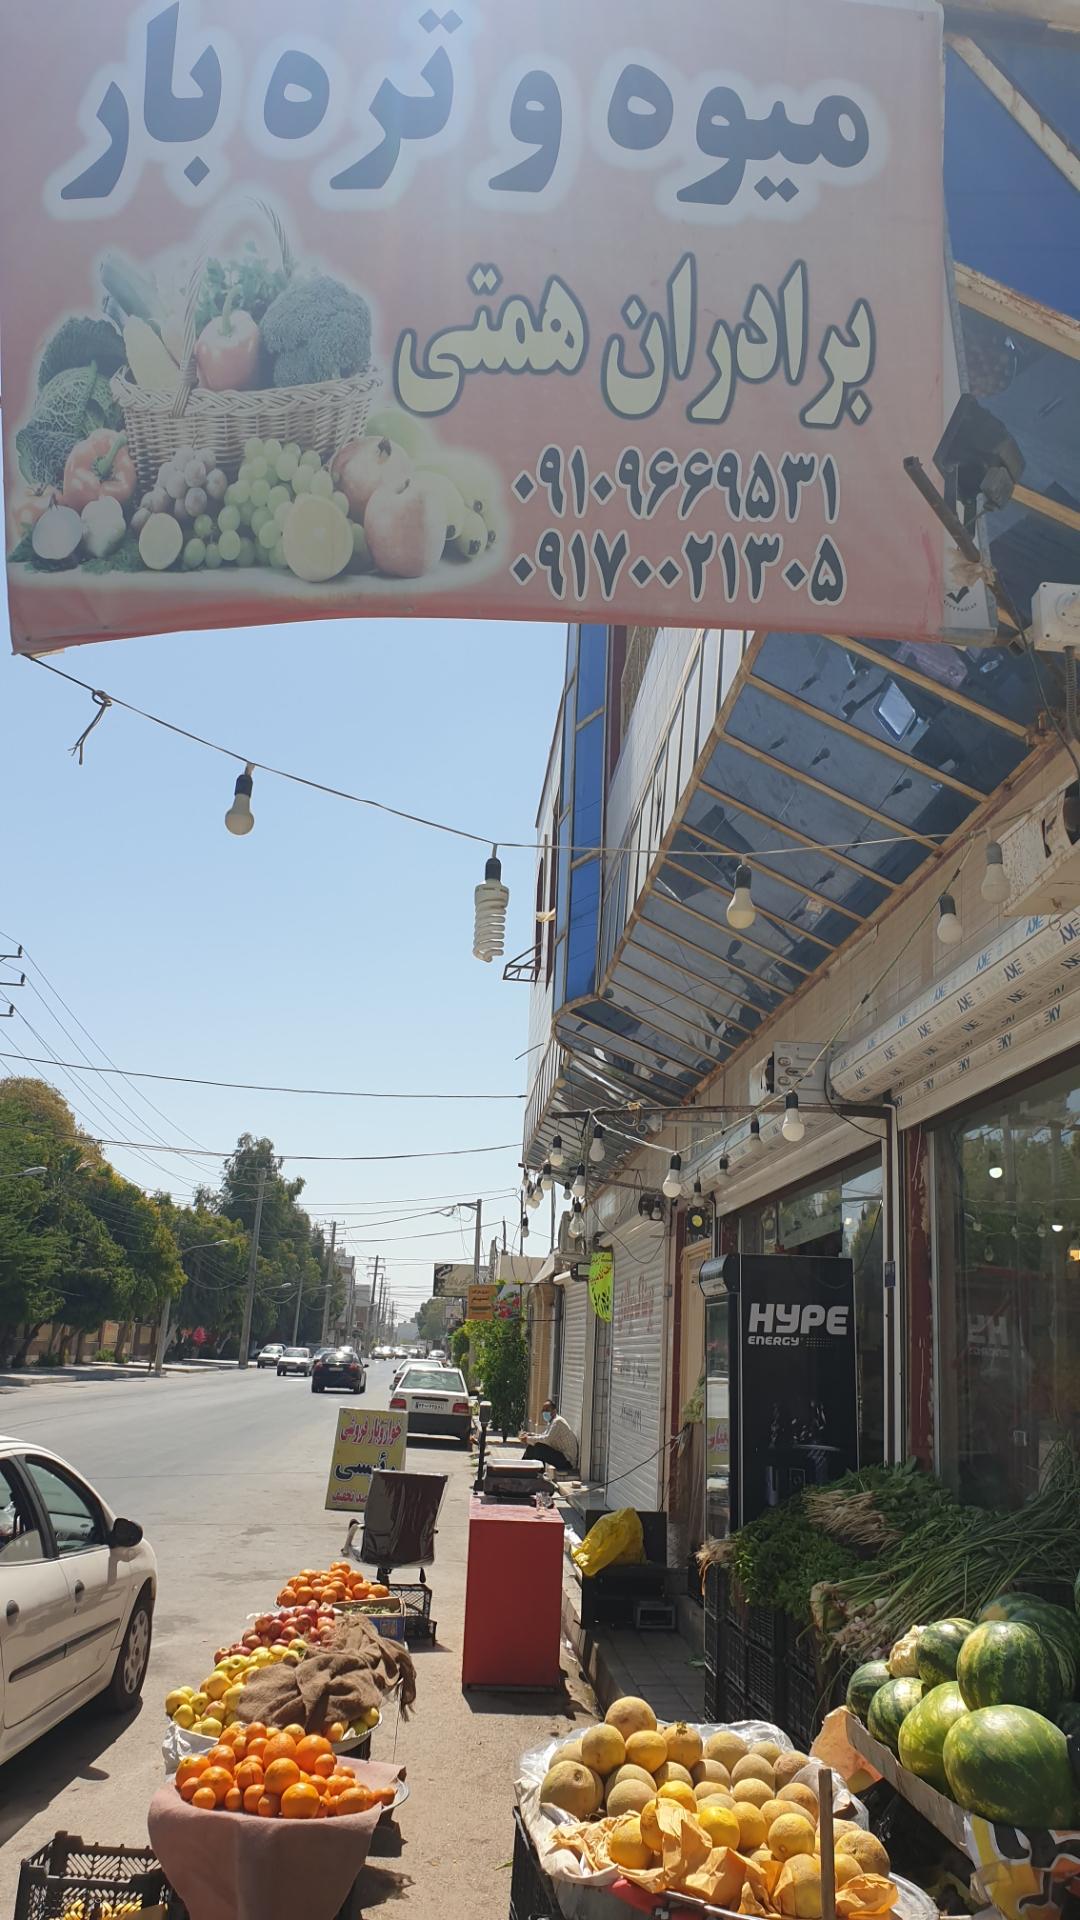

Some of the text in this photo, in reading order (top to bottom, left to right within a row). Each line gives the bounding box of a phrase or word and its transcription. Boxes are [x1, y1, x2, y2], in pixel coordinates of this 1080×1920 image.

[61, 0, 869, 205] میوه و تره بار
[393, 252, 876, 429] برادران همتی
[511, 443, 841, 523] ۰۹۱۰۹۶۶۹۵۳۱
[510, 528, 846, 604] ۰۹۱۷۰۰۲۱۳۰۵
[747, 1335, 800, 1347] ENERGY
[748, 1303, 849, 1335] HYPE
